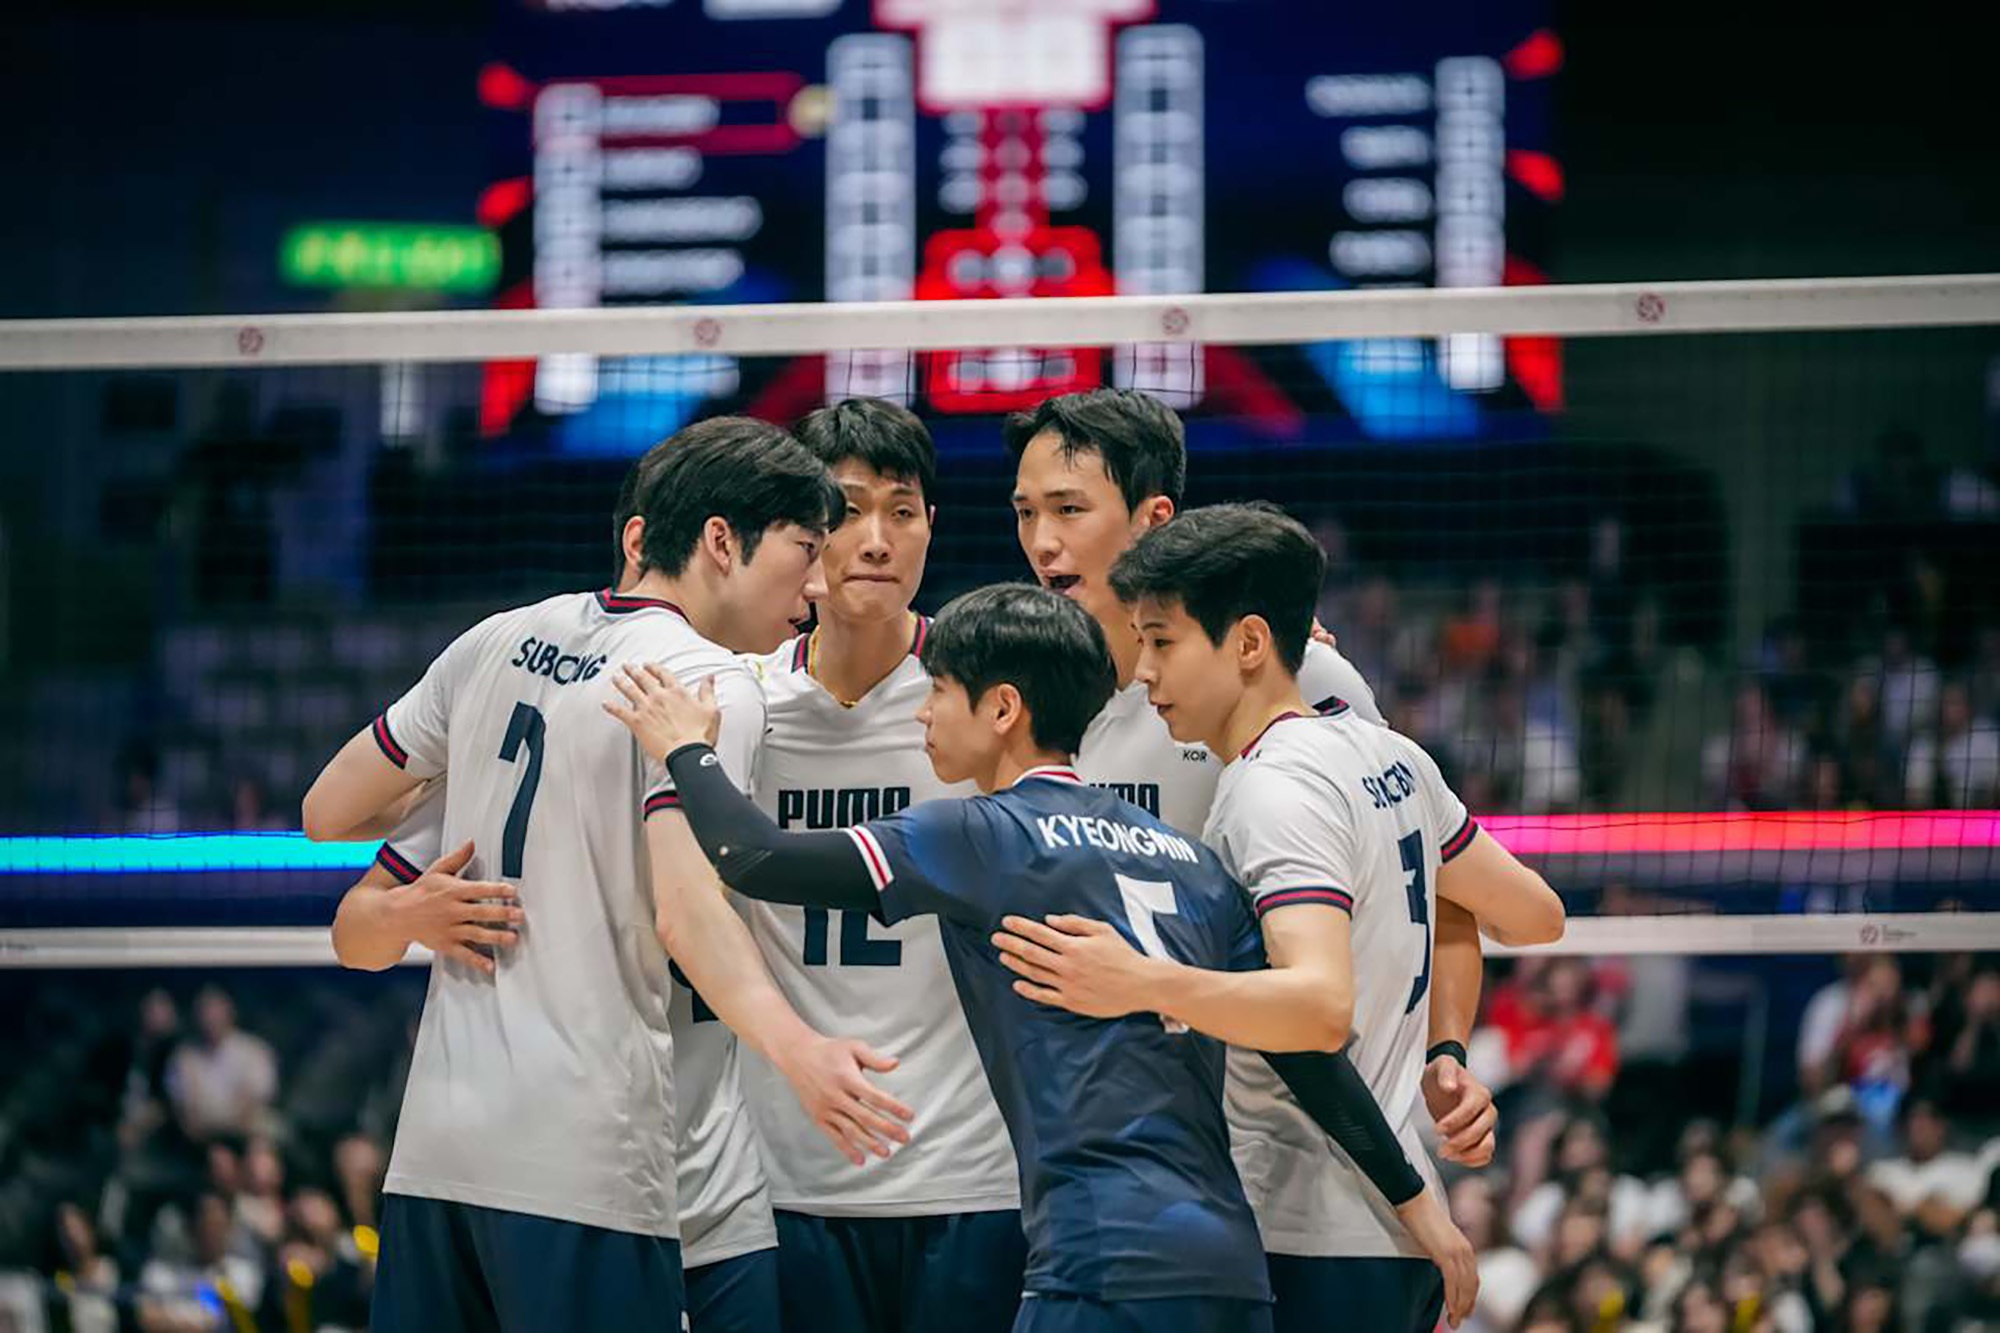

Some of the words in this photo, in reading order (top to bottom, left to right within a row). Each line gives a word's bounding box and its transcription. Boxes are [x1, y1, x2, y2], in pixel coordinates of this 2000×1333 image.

[1182, 750, 1208, 762] KOR
[498, 701, 547, 879] 7
[778, 786, 911, 829] PUMA
